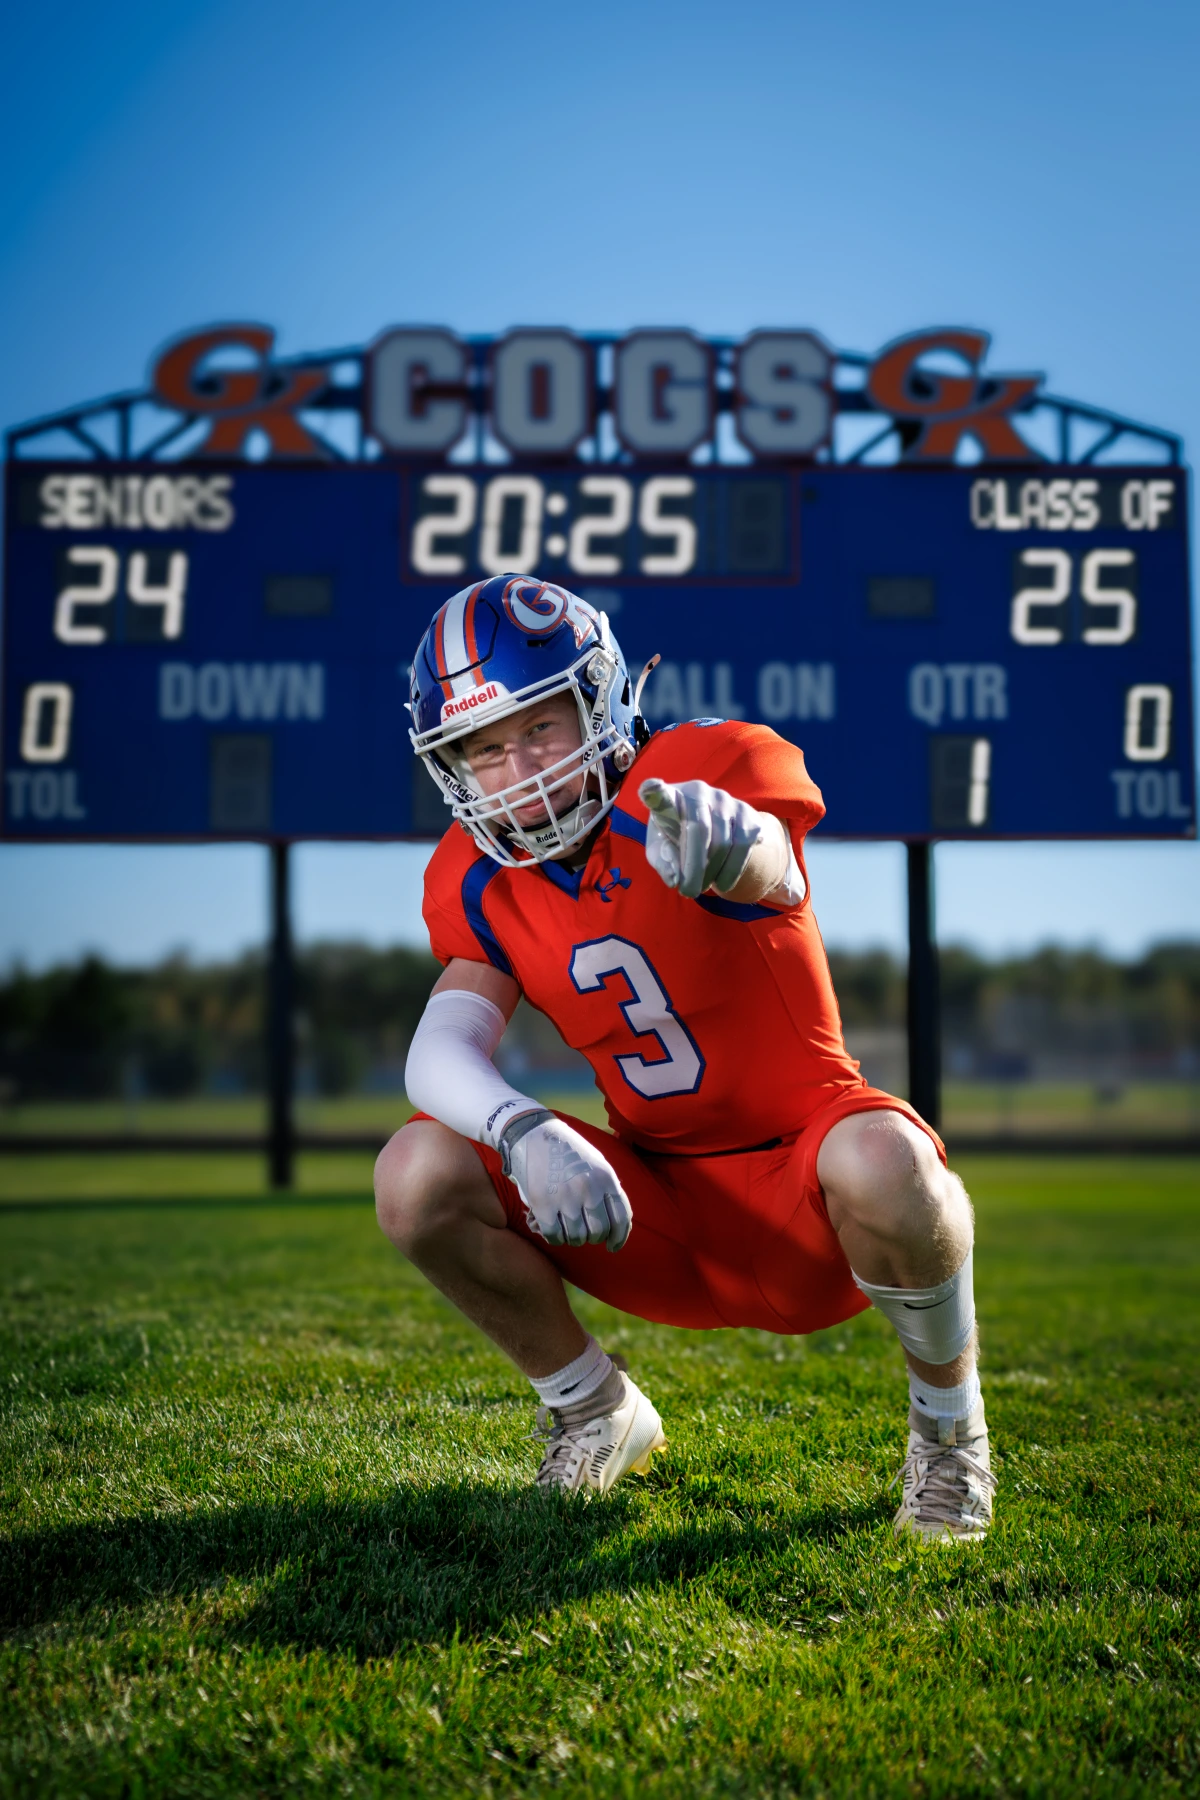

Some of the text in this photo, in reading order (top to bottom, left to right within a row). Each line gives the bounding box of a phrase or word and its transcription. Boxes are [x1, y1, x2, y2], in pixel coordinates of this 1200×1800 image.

[367, 327, 833, 456] COGS
[39, 475, 235, 532] SENIORS
[411, 475, 697, 576] 20:25
[970, 478, 1175, 531] CLASS OF
[54, 546, 188, 644] 24
[1011, 548, 1136, 645] 25
[159, 662, 325, 720] DOWN
[443, 684, 499, 719] Riddell
[758, 662, 835, 721] ON
[909, 662, 1008, 722] QTR
[21, 682, 73, 763] 0
[1125, 684, 1171, 761] 0
[7, 771, 87, 820] TOL
[443, 774, 479, 803] Riddel
[968, 738, 990, 825] 1
[1111, 769, 1191, 818] TOL
[568, 933, 706, 1101] 3
